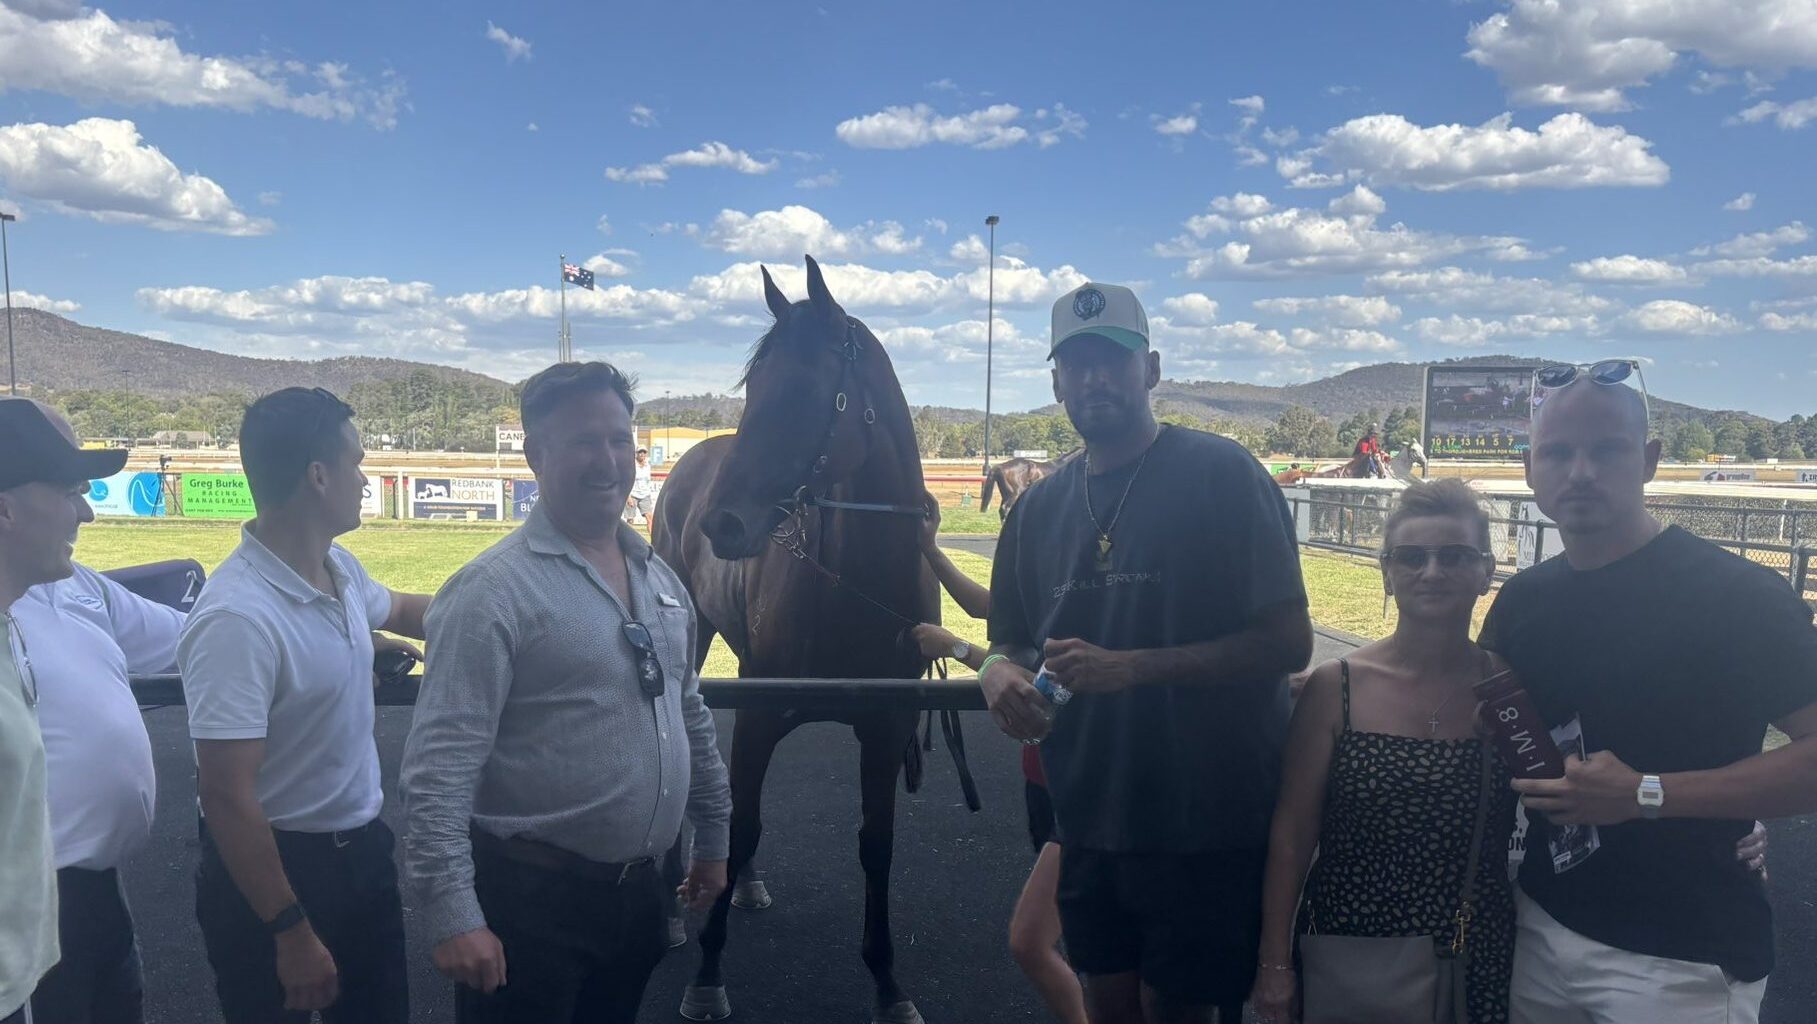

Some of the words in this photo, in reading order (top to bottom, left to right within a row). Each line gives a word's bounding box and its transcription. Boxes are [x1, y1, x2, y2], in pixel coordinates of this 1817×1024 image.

[1432, 438, 1442, 447] 10
[1446, 438, 1456, 446] 17
[1461, 438, 1471, 446] 13
[1476, 438, 1485, 446] 14
[1493, 438, 1500, 447] 5
[1508, 438, 1514, 446] 7
[189, 479, 213, 490] Greg
[215, 479, 244, 488] Burke
[451, 479, 495, 488] REDBANK
[451, 489, 495, 501] NORTH
[181, 570, 198, 602] 2
